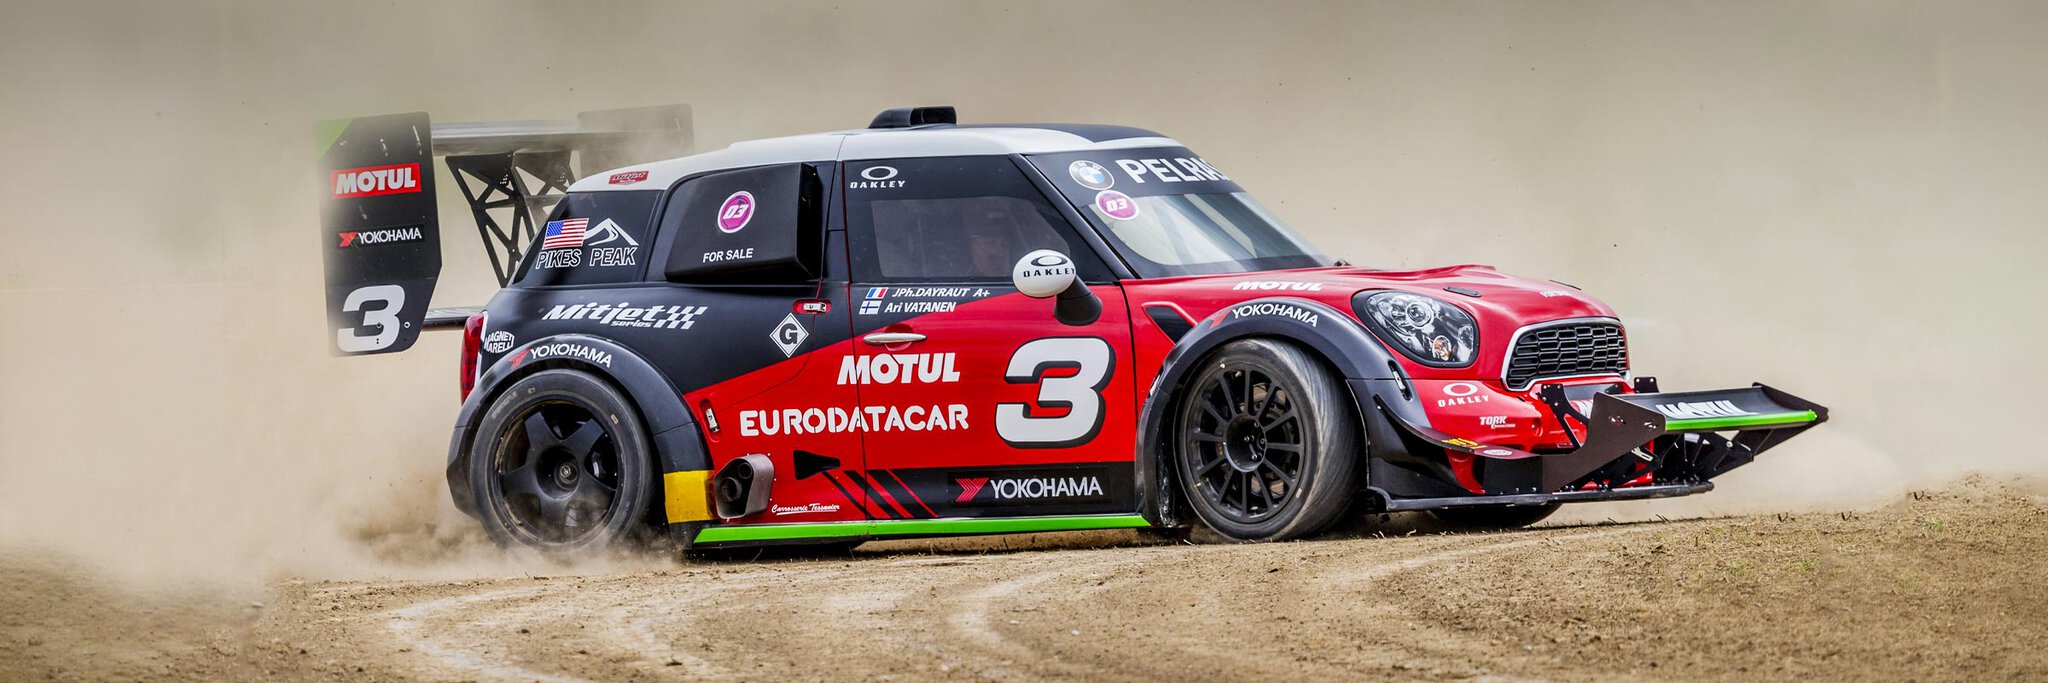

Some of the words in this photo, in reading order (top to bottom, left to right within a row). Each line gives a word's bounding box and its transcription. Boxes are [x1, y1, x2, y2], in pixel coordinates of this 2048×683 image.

[335, 167, 416, 194] MOTUL
[850, 180, 905, 189] OAKLEY
[722, 203, 749, 220] 03
[1106, 198, 1128, 212] 03
[357, 227, 422, 245] YOKOHAMA
[535, 249, 582, 270] PIKES
[589, 247, 638, 267] PEAK
[703, 251, 724, 263] FOR
[725, 248, 754, 260] SALE
[973, 288, 991, 297] A+
[1232, 281, 1323, 291] MOTUL
[337, 284, 406, 352] 3
[542, 302, 667, 324] Mitjet
[884, 302, 903, 313] Ari
[904, 302, 957, 313] VATANEN
[1232, 303, 1319, 327] YOKOHAMA
[611, 319, 652, 328] series
[780, 323, 799, 345] G
[530, 343, 613, 368] YOKOHAMA
[837, 353, 961, 385] MOTUL
[996, 336, 1114, 446] 3
[1438, 395, 1489, 408] OAKLEY
[739, 404, 969, 437] EURODATACAR
[991, 476, 1103, 499] YOKOHAMA
